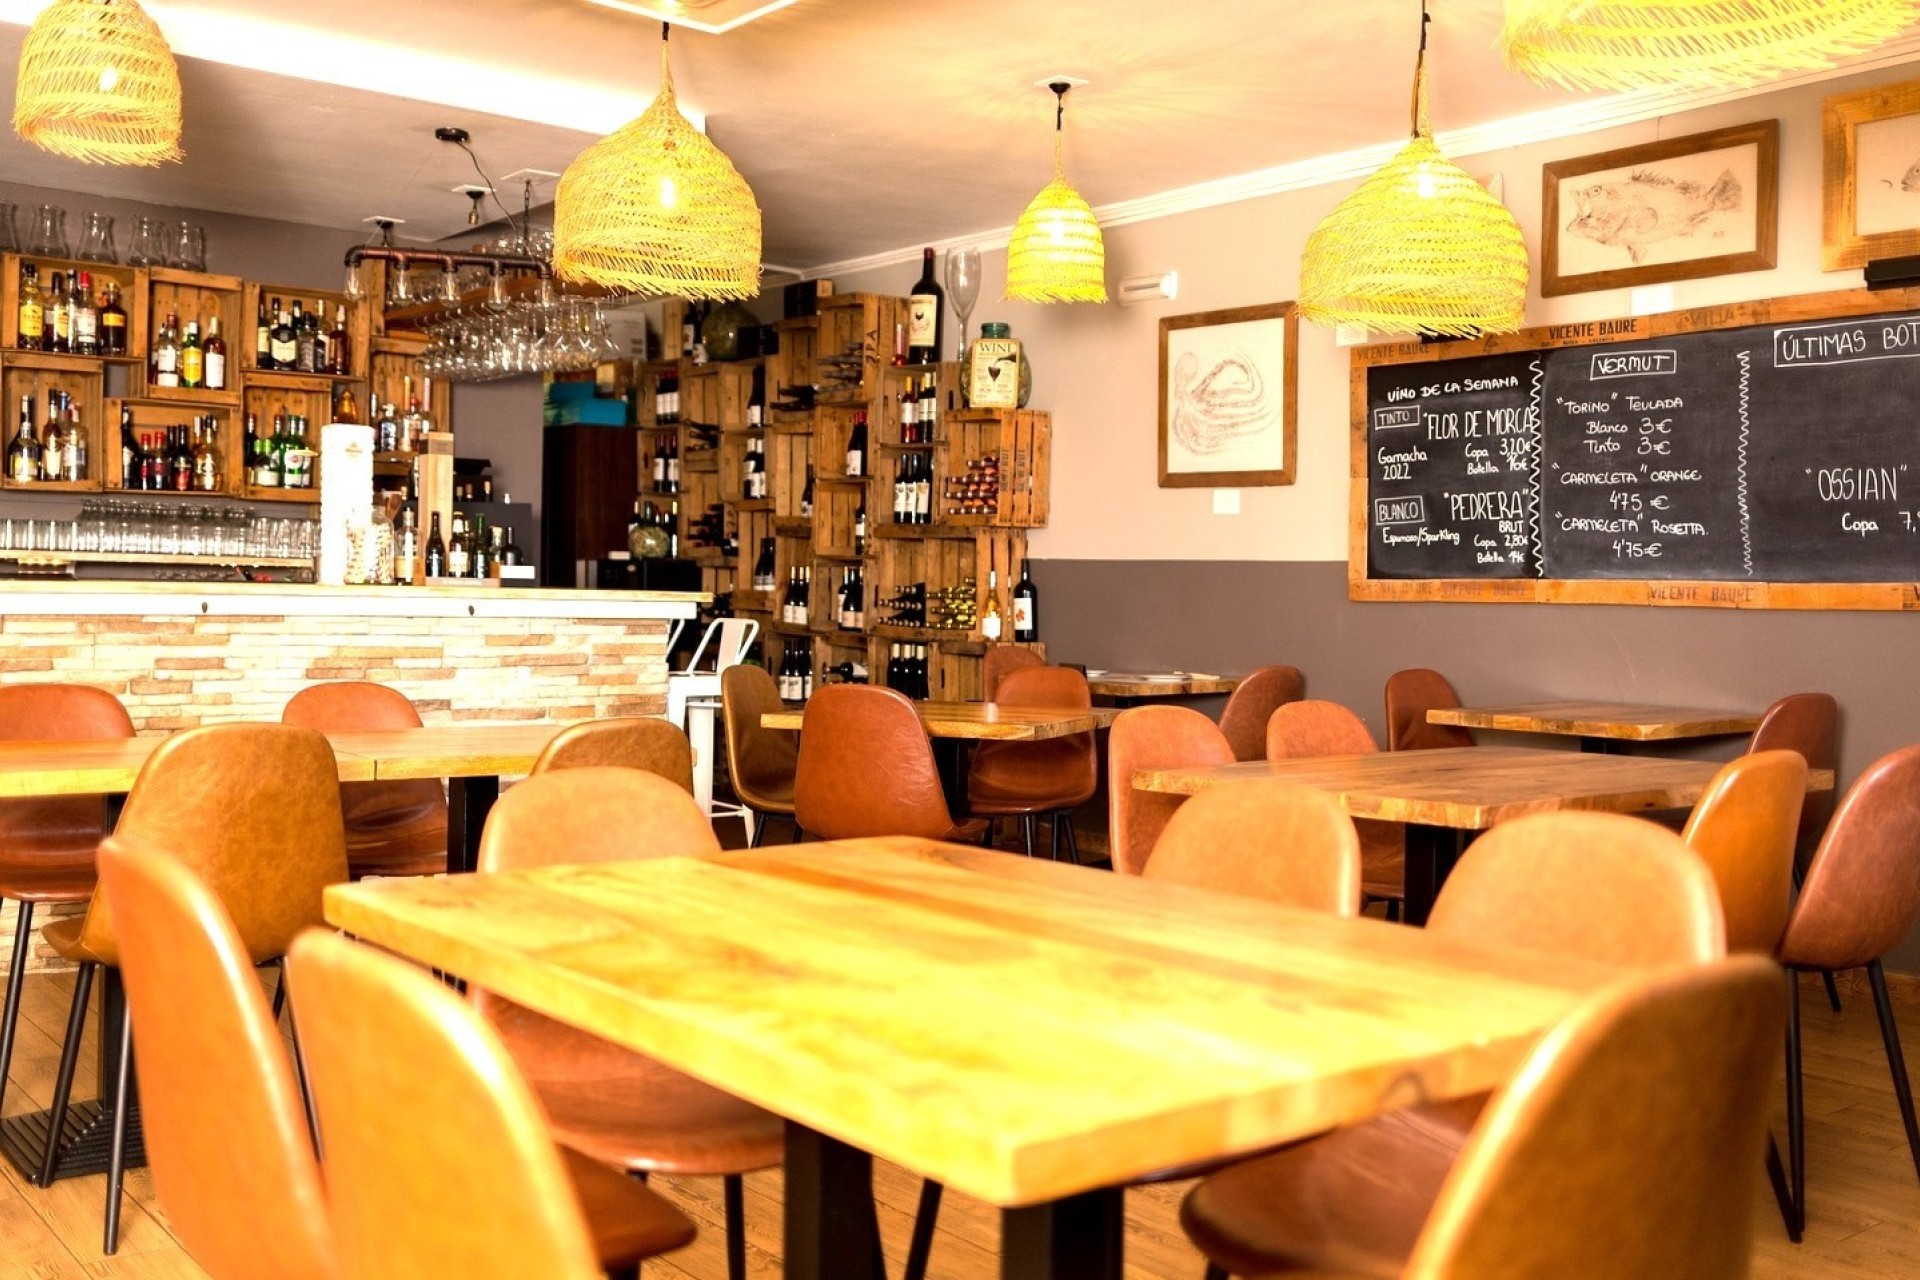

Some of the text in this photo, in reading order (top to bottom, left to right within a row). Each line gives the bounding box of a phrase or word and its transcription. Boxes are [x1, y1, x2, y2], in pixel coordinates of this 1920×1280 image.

[1550, 318, 1638, 340] VICENTE BAURE
[1357, 345, 1394, 361] VICENTE
[1783, 329, 1866, 361] ÚLTIMAS
[1597, 355, 1670, 375] VERMUT
[1420, 384, 1441, 397] DE
[1444, 382, 1461, 393] LA
[1464, 375, 1519, 391] SEMANA
[1378, 410, 1411, 426] TINTO
[1465, 410, 1483, 438] DE
[1585, 421, 1628, 435] Blanco
[1465, 442, 1489, 462] Copa
[1583, 437, 1621, 454] Tinto
[1382, 463, 1412, 480] 2022
[1467, 461, 1500, 475] Botella
[1650, 495, 1670, 510] €
[1378, 501, 1419, 522] BLANCO
[1499, 520, 1525, 533] BRUT
[1841, 512, 1879, 538] Copa
[1474, 533, 1497, 550] Copa
[1477, 551, 1505, 564] Botella
